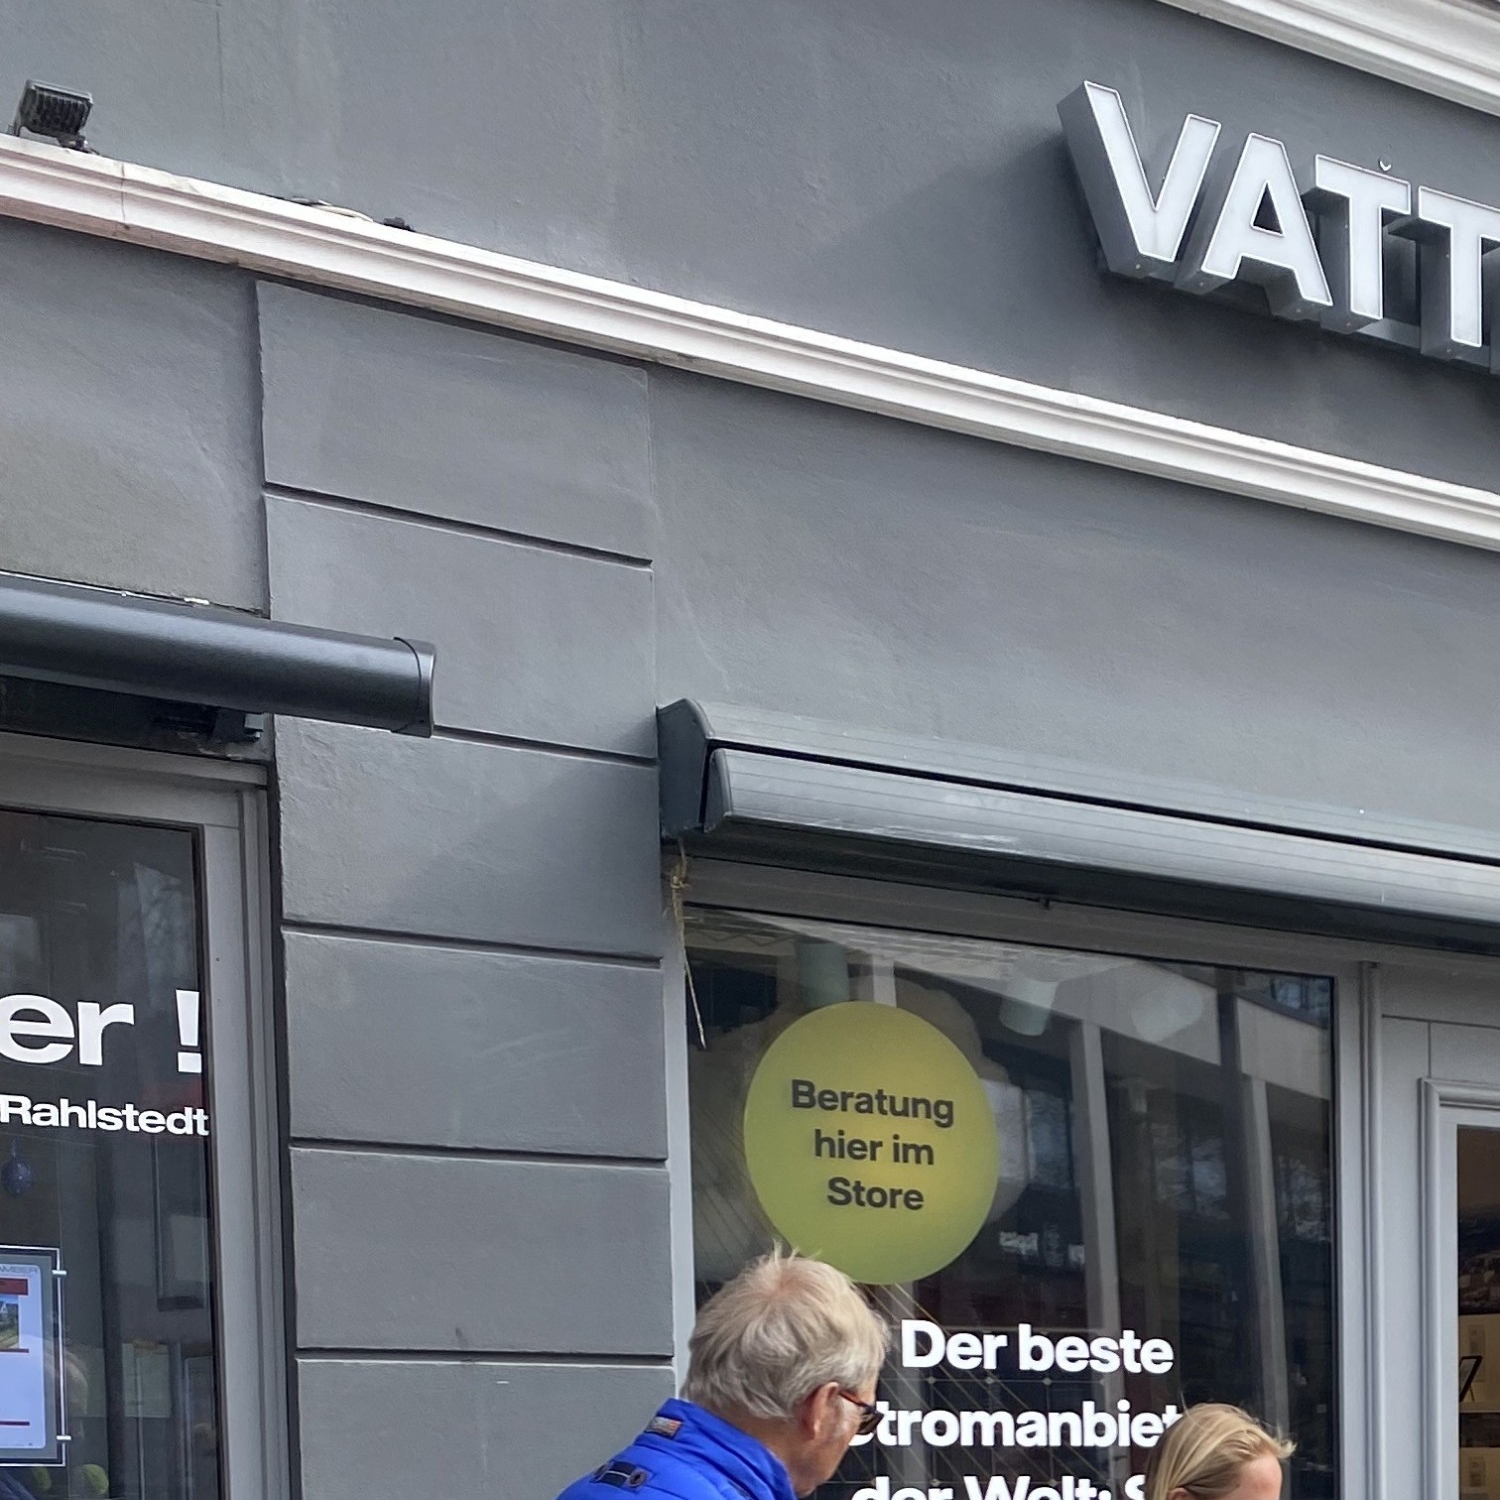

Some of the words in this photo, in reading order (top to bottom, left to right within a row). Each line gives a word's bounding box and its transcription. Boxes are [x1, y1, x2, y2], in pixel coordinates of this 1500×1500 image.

[175, 988, 202, 1073] !
[0, 1093, 210, 1136] Rahlstedt
[790, 1078, 955, 1129] Beratung
[813, 1128, 883, 1163] hier
[892, 1135, 935, 1166] im
[827, 1176, 925, 1211] Store
[901, 1319, 1007, 1370] Der
[1018, 1323, 1175, 1374] beste
[848, 1398, 1183, 1448] tromanbiet
